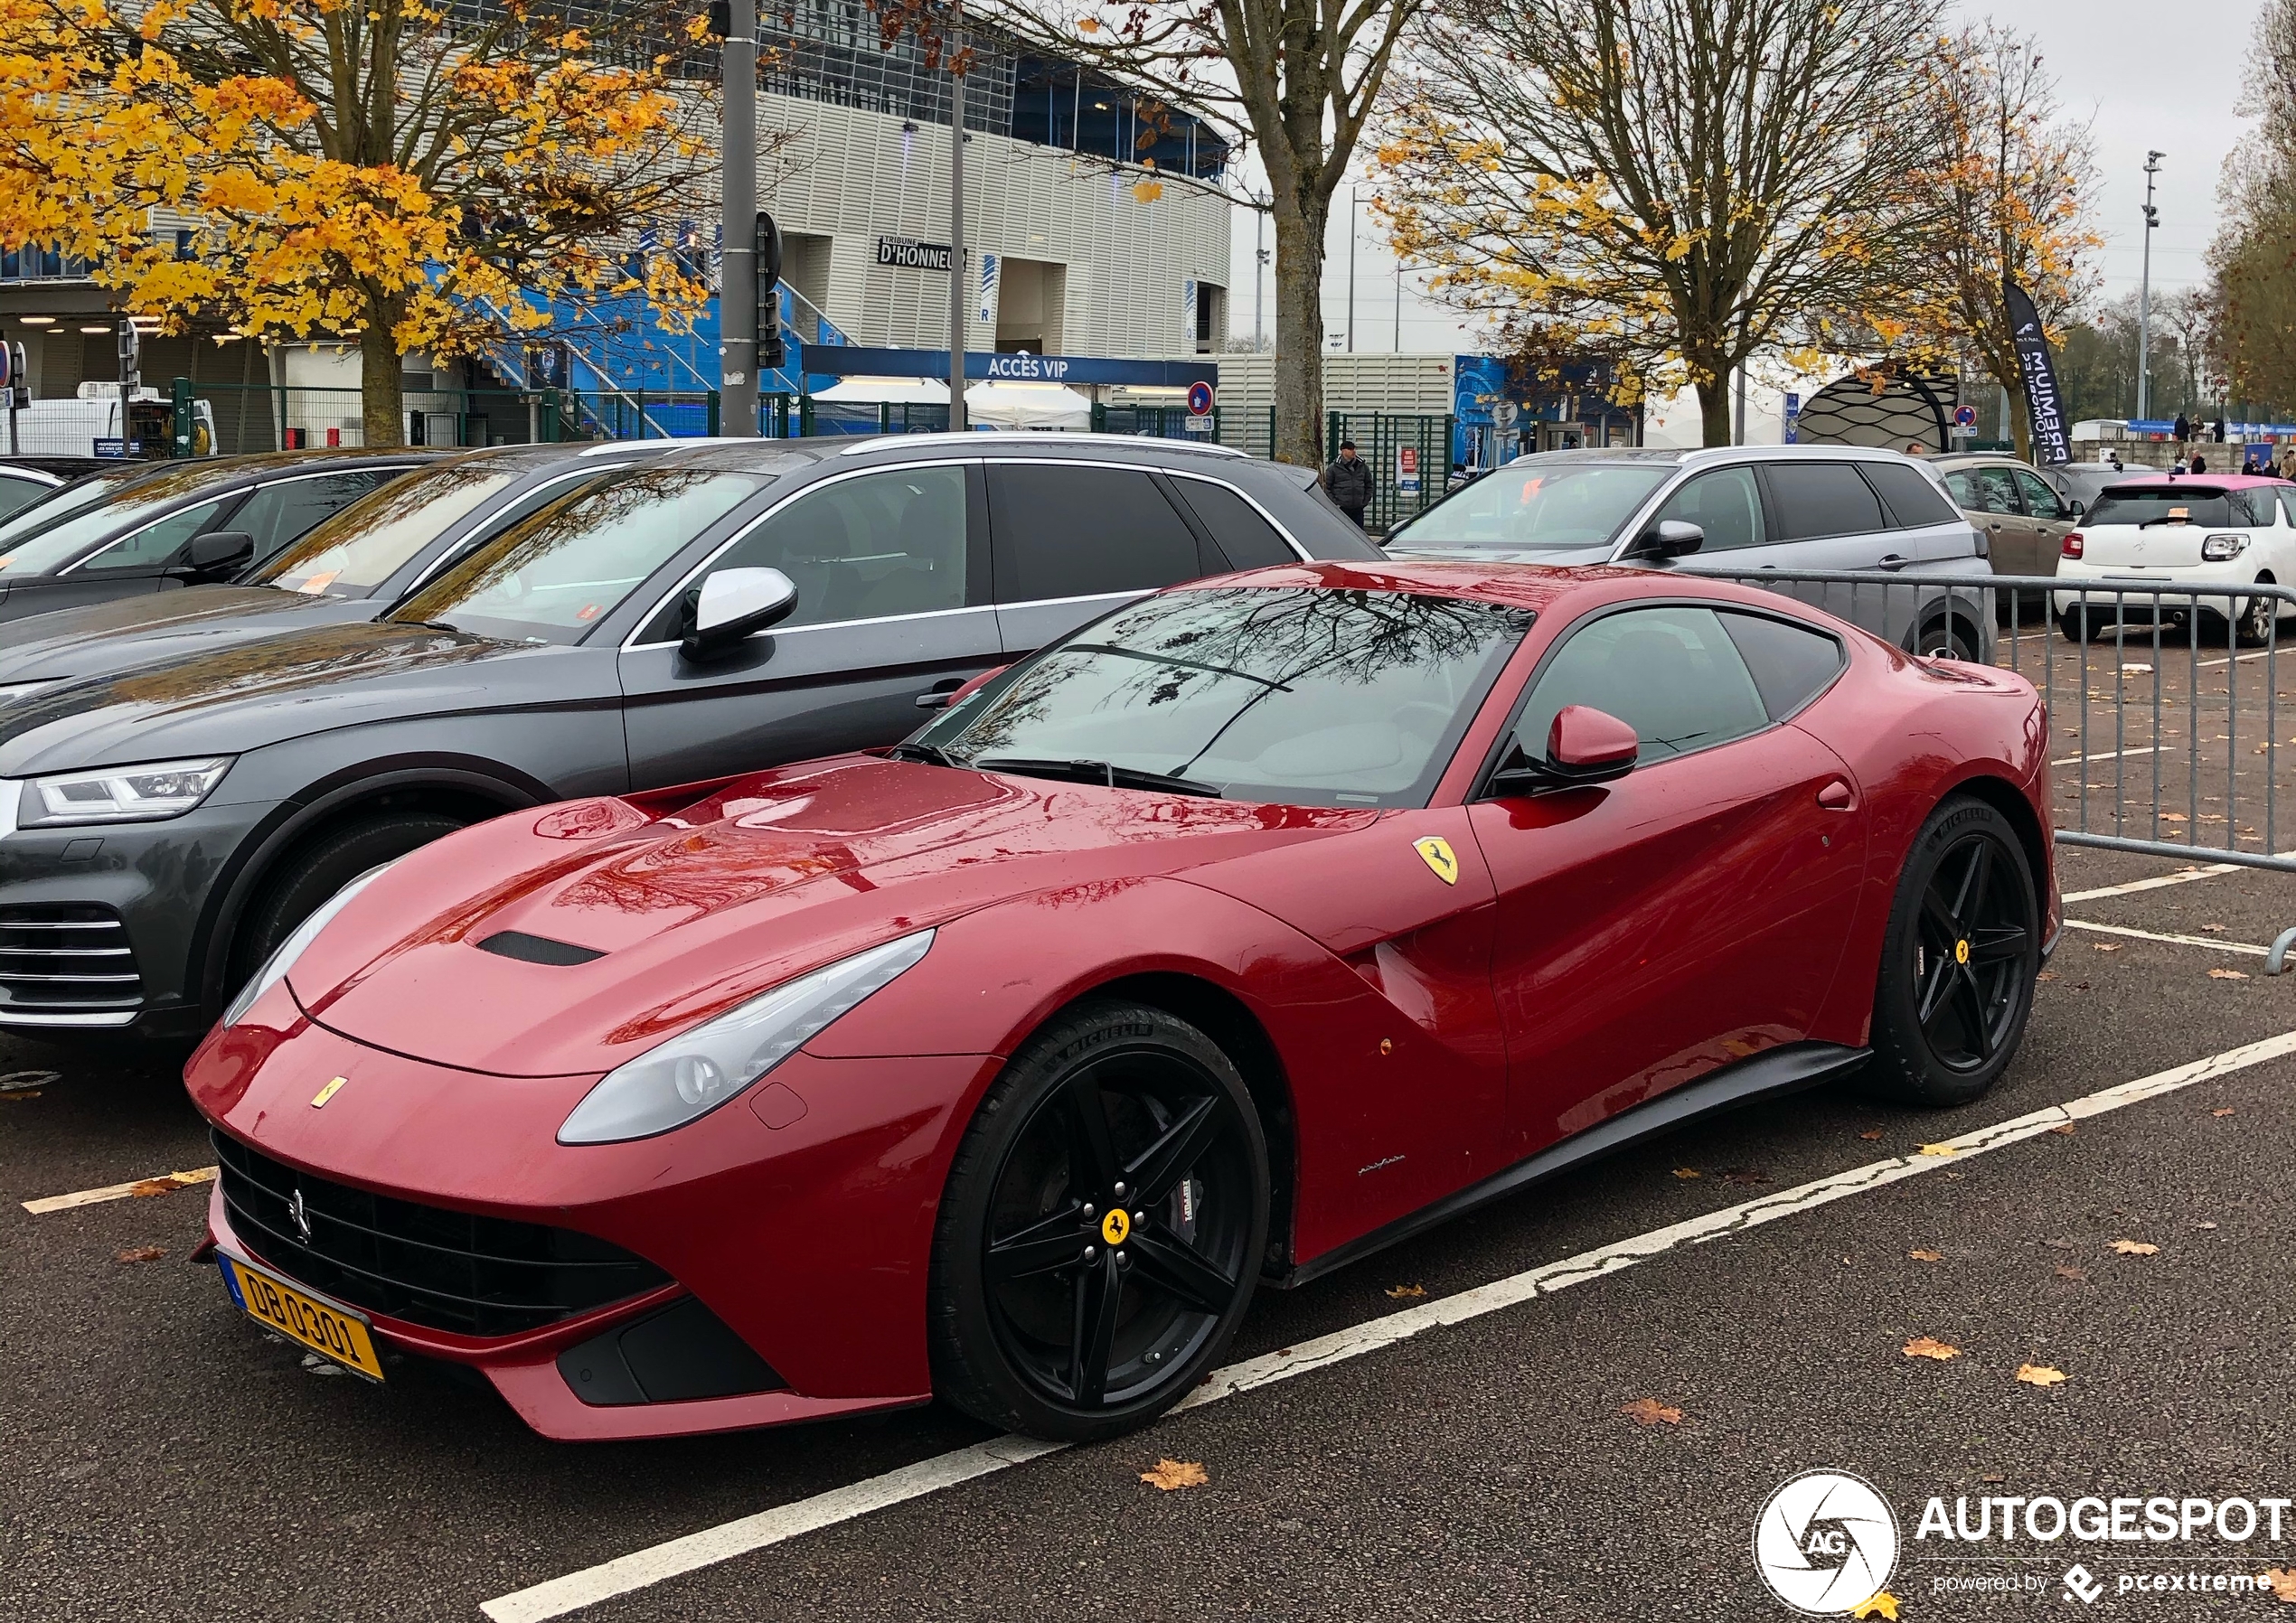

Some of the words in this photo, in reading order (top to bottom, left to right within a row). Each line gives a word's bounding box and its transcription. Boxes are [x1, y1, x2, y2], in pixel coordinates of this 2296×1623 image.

[885, 235, 917, 246] TRIBUNE
[981, 308, 989, 322] R
[1186, 327, 1192, 339] Q
[987, 355, 1040, 378] ACCÈS
[1042, 361, 1068, 378] VIP
[1939, 809, 1990, 838] MICHELIN
[1067, 1024, 1149, 1057] MICHELIN
